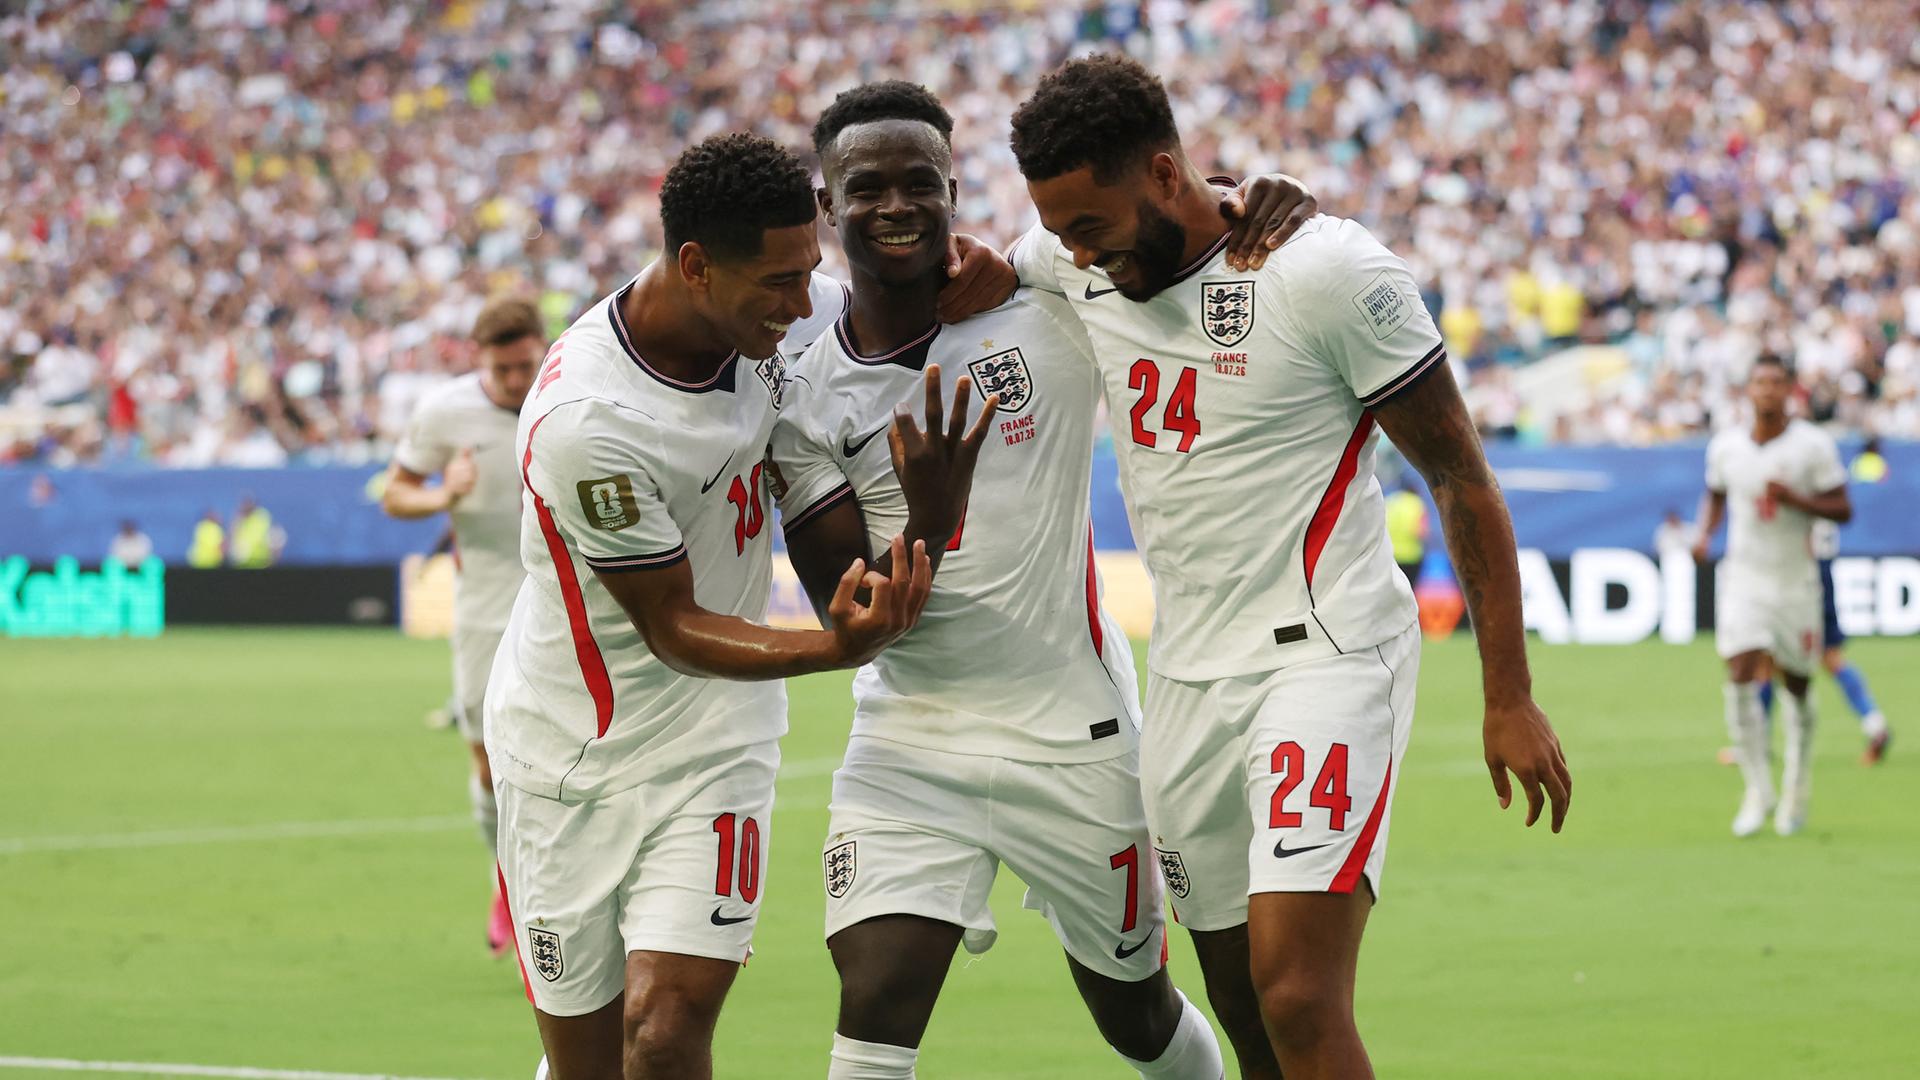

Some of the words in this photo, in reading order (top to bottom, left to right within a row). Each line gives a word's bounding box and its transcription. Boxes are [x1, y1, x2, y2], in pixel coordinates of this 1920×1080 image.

[1362, 280, 1390, 307] FOOTBALL
[1367, 287, 1398, 316] UNITES
[1211, 352, 1248, 364] FRANCE
[1214, 362, 1246, 377] 18.07.26
[1127, 358, 1201, 453] 24
[1000, 414, 1035, 434] FRANCE
[1004, 428, 1036, 447] 18.07.26
[727, 459, 765, 557] 10
[1269, 741, 1352, 832] 24
[713, 812, 760, 905] 10
[1109, 842, 1138, 933] 7
